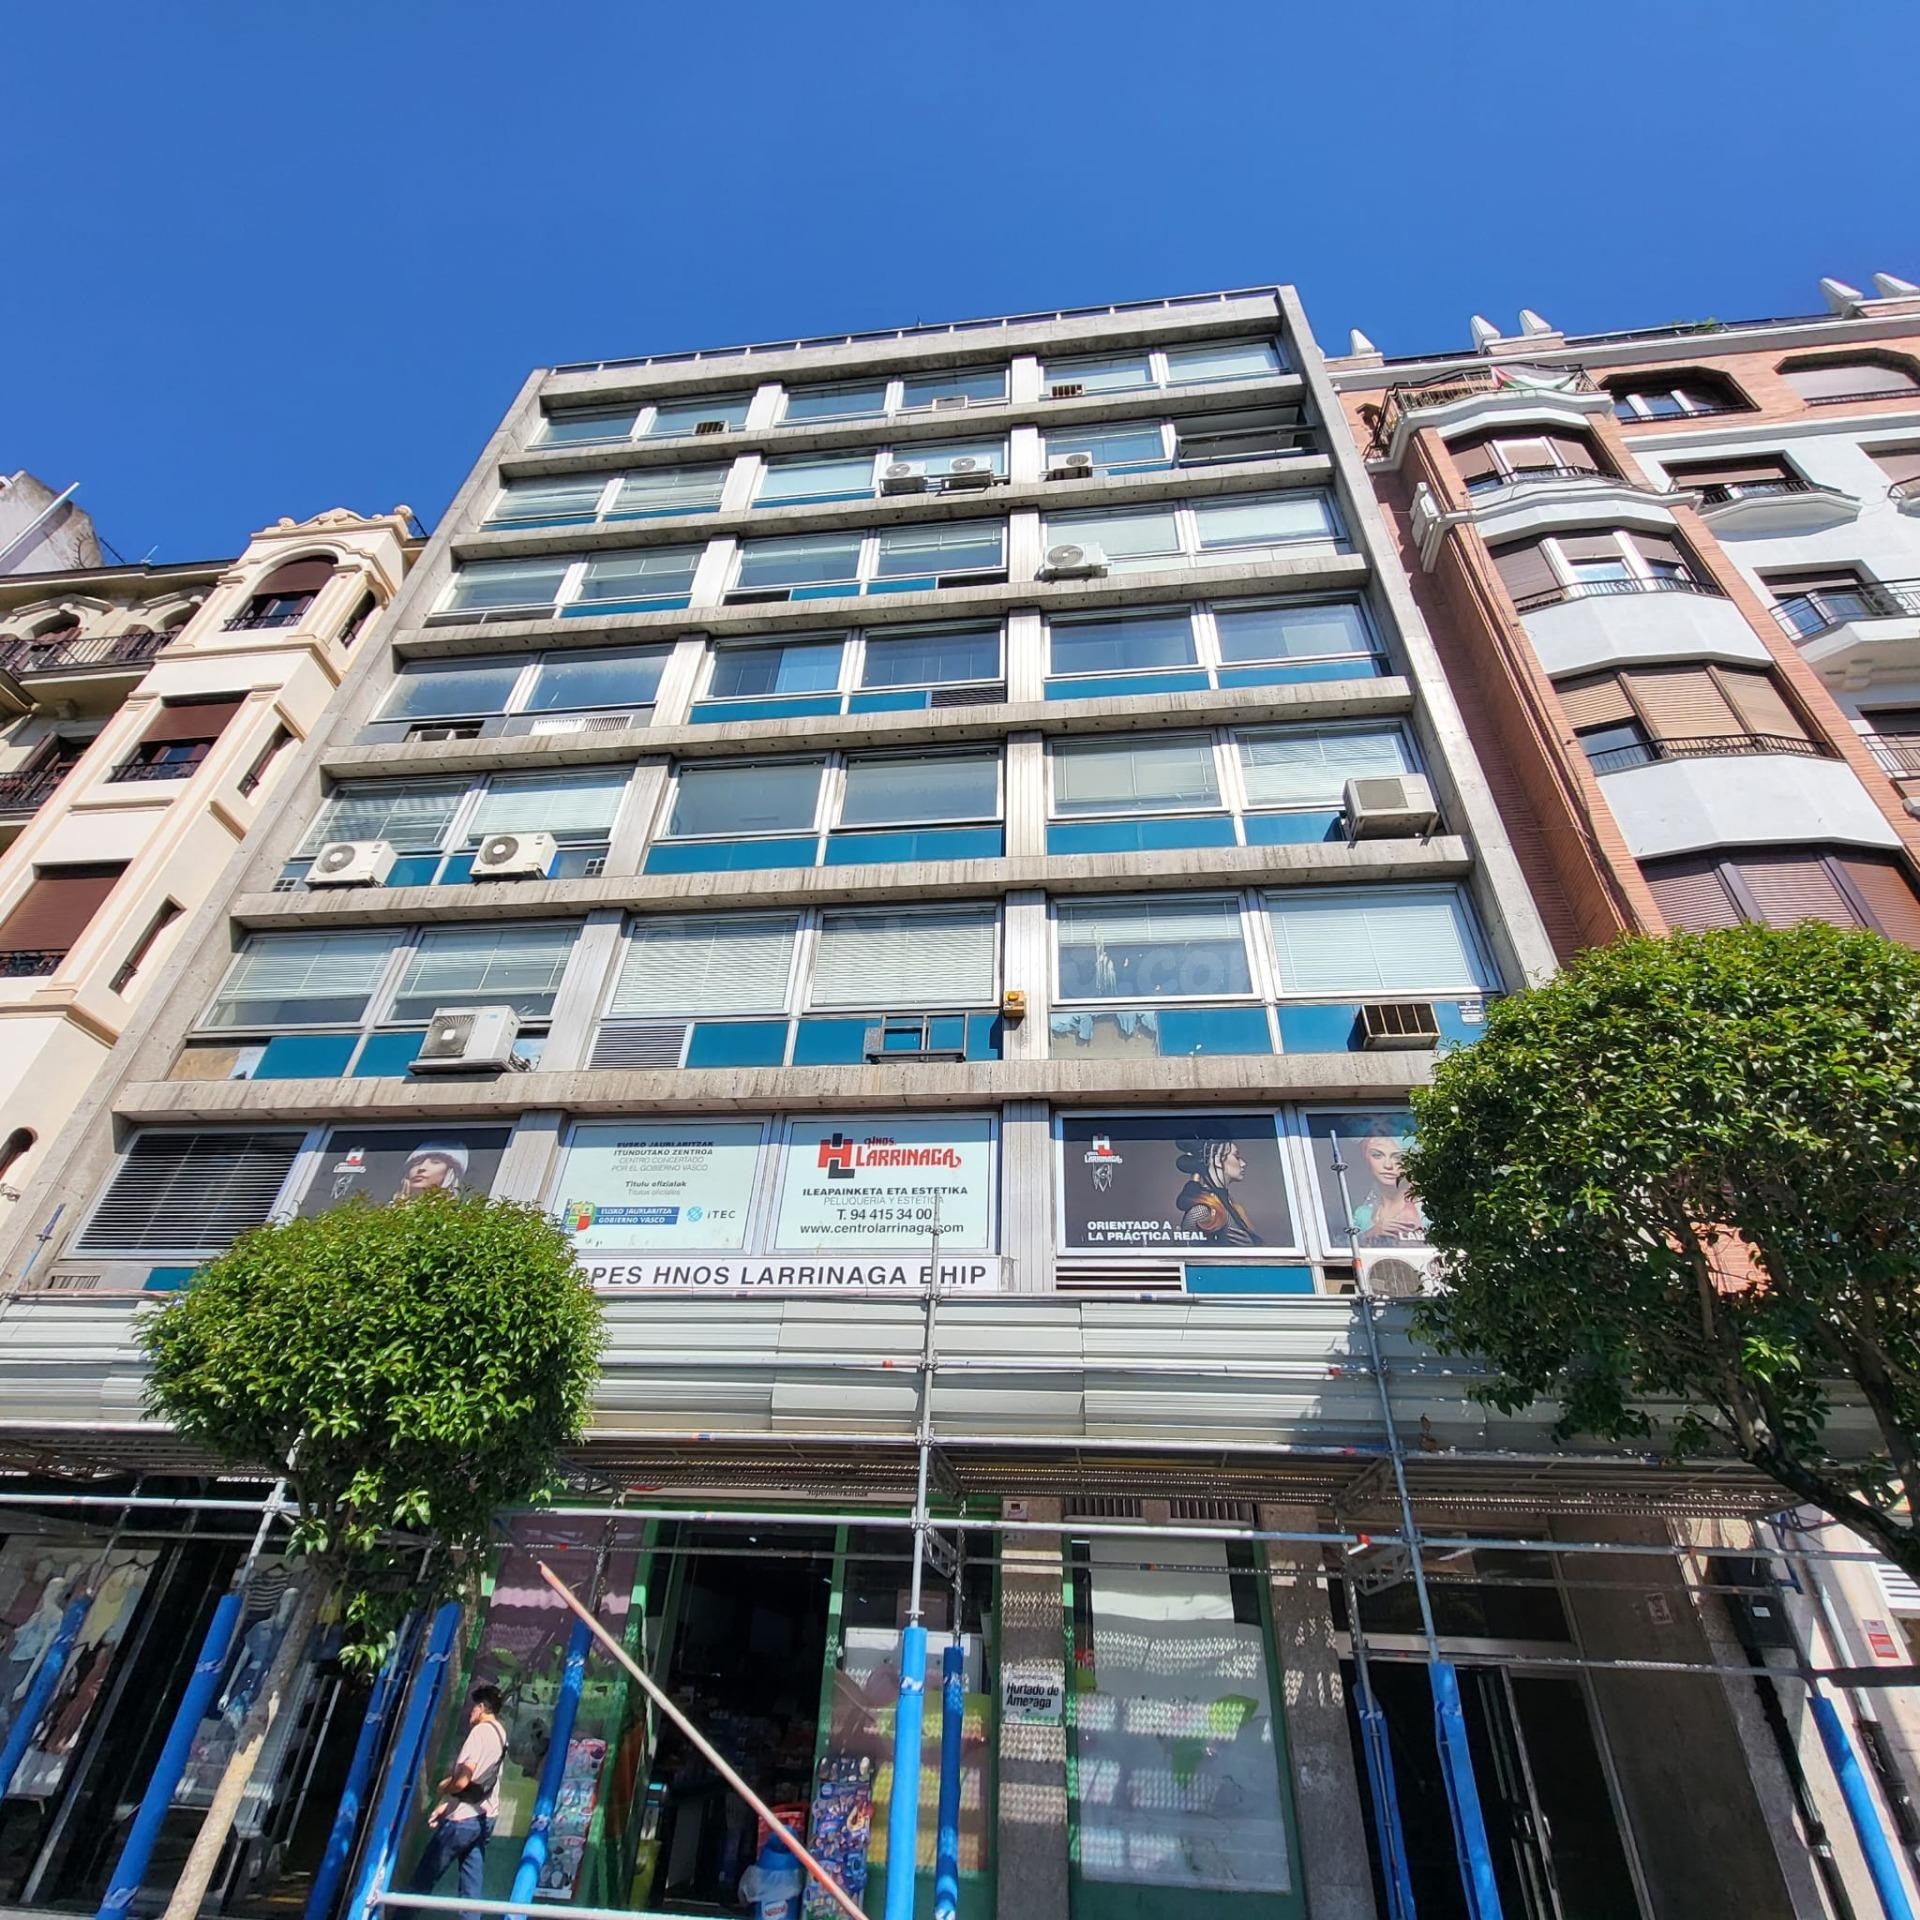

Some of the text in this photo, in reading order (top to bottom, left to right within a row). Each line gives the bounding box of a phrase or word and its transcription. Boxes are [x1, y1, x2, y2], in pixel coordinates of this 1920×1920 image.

[855, 1146, 961, 1168] LARRINAGA
[802, 1188, 883, 1196] ILEAPAINKETA
[912, 1187, 968, 1195] ESTETIKA
[837, 1208, 932, 1220] T. 94 415 34 00
[800, 1223, 964, 1235] www.centrolarrinagaom
[1087, 1221, 1172, 1230] ORIENTADO A
[1088, 1230, 1207, 1241] LA PRÁCTICA REAL
[653, 1265, 730, 1285] HNOS
[741, 1265, 907, 1285] LARRINAGA
[1007, 1682, 1059, 1696] Hurtado de
